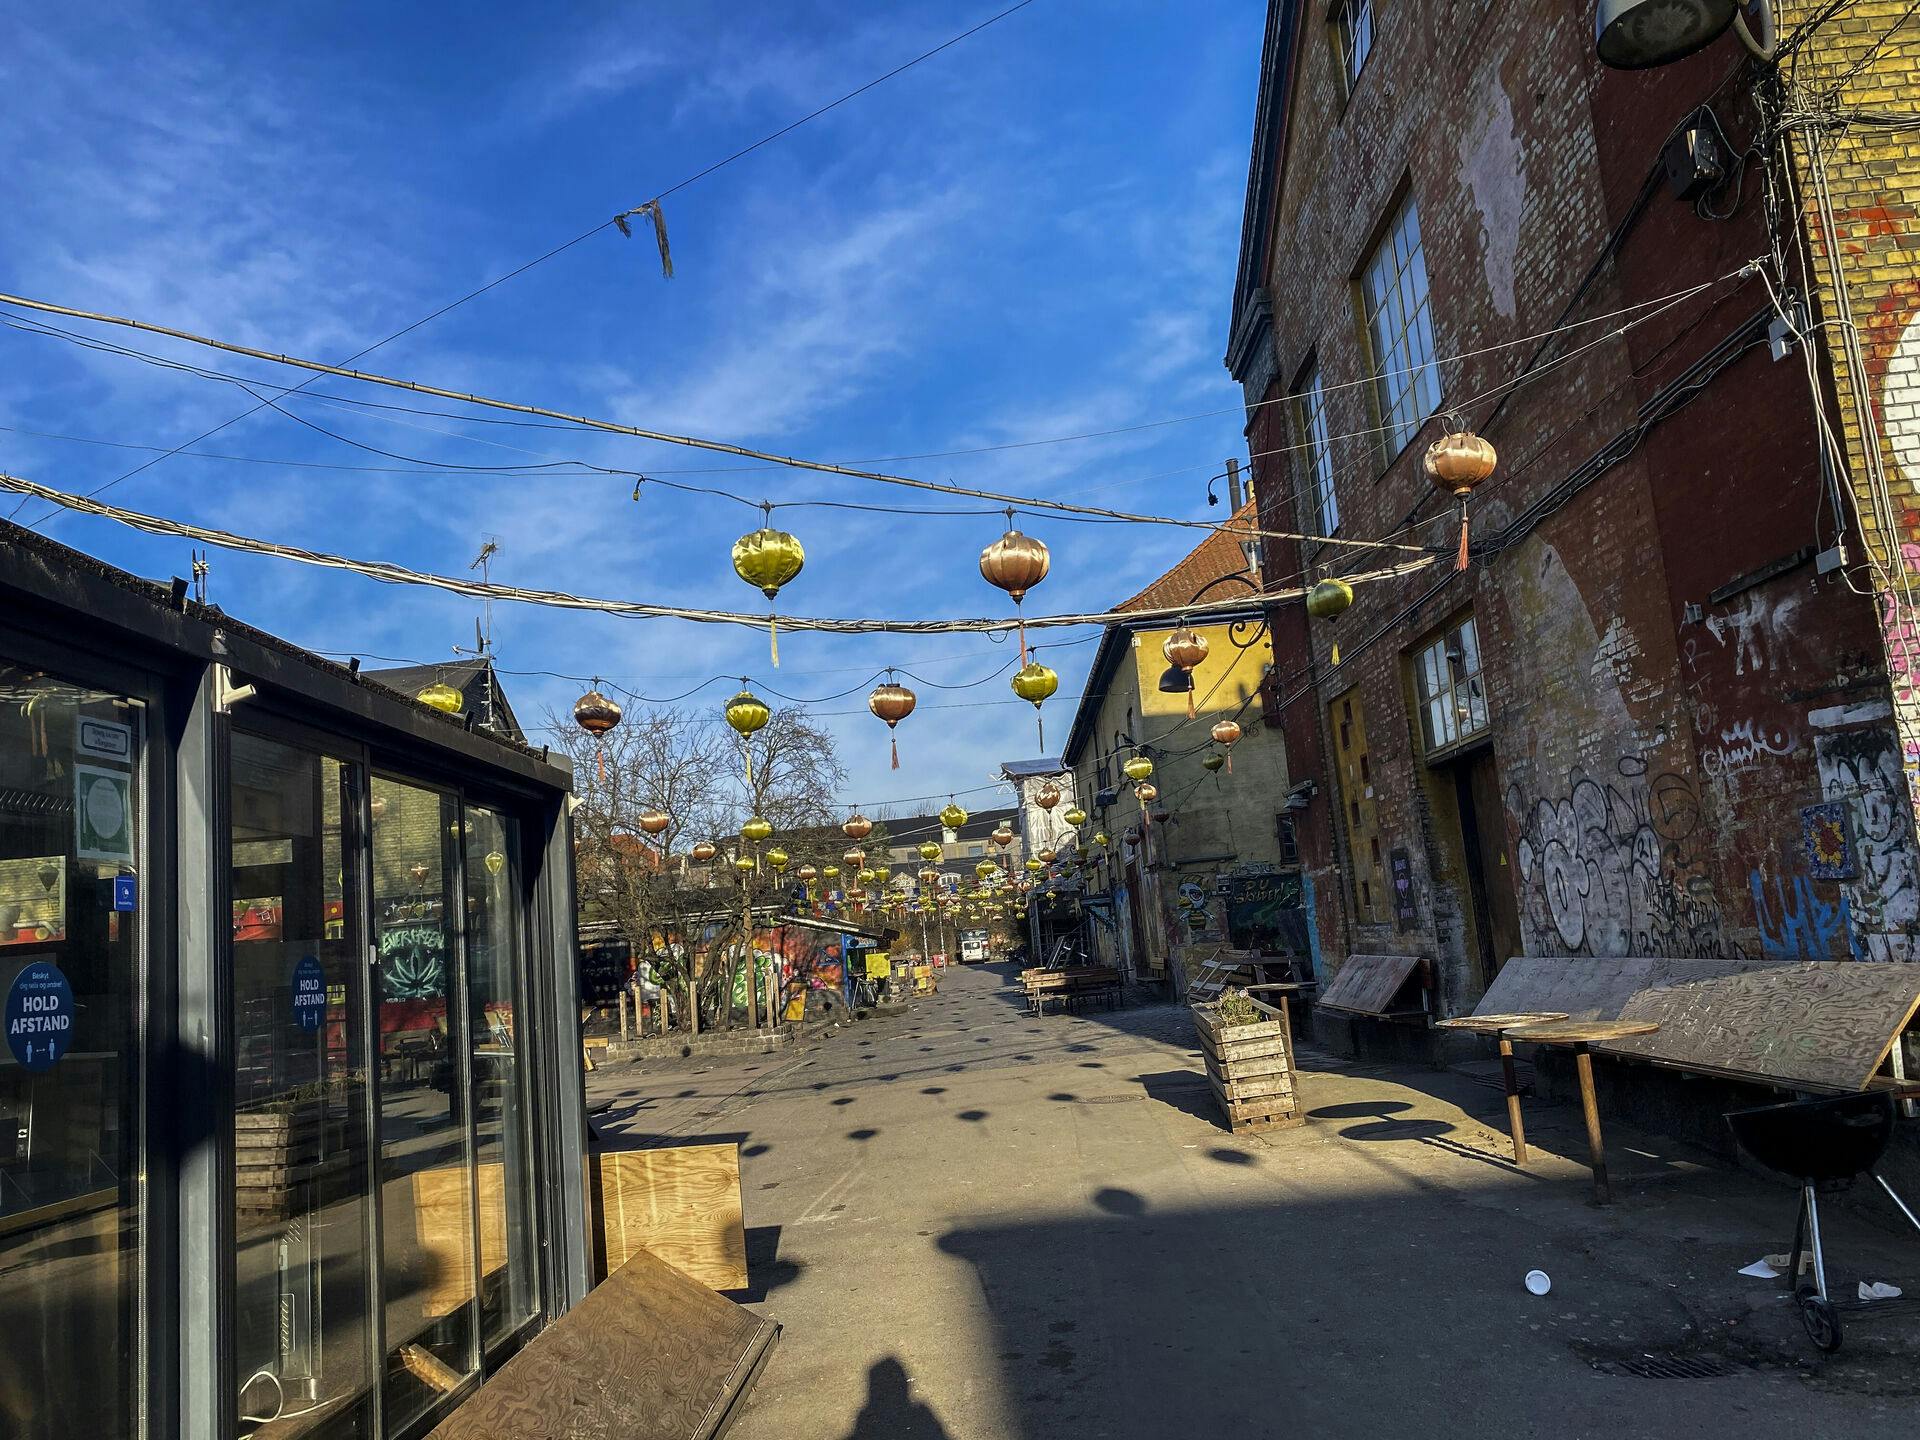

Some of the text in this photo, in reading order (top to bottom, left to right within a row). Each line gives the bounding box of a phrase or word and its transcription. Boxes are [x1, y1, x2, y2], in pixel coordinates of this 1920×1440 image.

[300, 979, 319, 991] HOLD
[23, 995, 59, 1012] HOLD
[294, 993, 325, 1007] AFSTAND
[10, 1015, 70, 1034] AFSTAND
